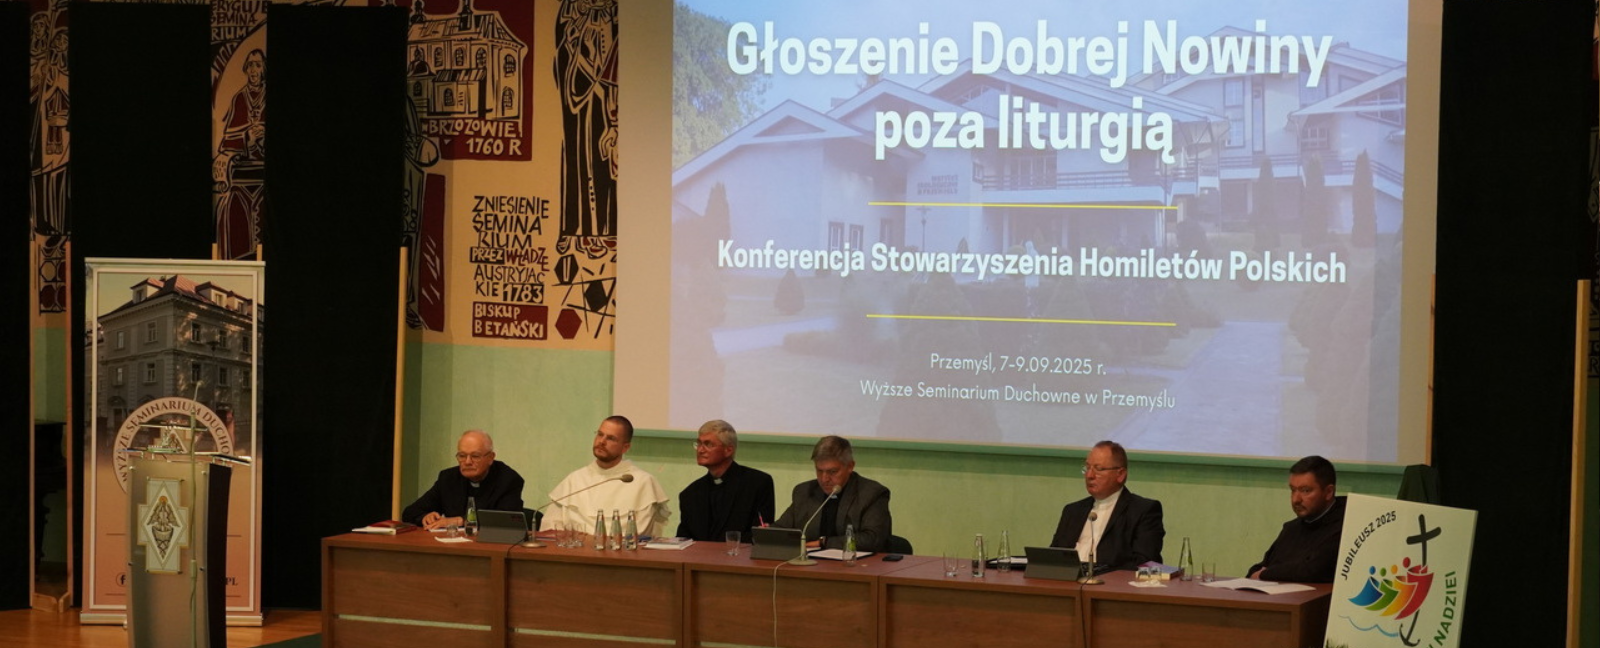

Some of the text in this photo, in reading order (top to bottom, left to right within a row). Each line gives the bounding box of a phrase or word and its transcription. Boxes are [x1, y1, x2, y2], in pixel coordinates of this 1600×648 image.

[727, 19, 1333, 88] Głoszenie Dobrej Nowiny
[429, 118, 517, 138] BRZOZOWIE
[875, 94, 1176, 164] poza liturgią
[465, 137, 523, 156] 1760 R
[472, 195, 550, 219] ZNIESIENIE
[472, 213, 542, 236] SEMINA
[477, 230, 533, 250] RIUM
[472, 247, 505, 262] PRZEZ
[717, 239, 1347, 283] Konferencja Stowarzyszenia Homiletów Polskich
[473, 264, 545, 284] AUSTRYJAC
[475, 281, 543, 303] KIE 1783
[474, 303, 521, 320] BISKUP
[930, 352, 1106, 375] Przemyśl, 7-9.09.2025 r.
[860, 380, 1176, 412] Wyższe Seminarium Duchowne w Przemyślu
[1341, 511, 1397, 580] JUBILEUSZ 2025
[1434, 571, 1457, 646] NADZIEI
